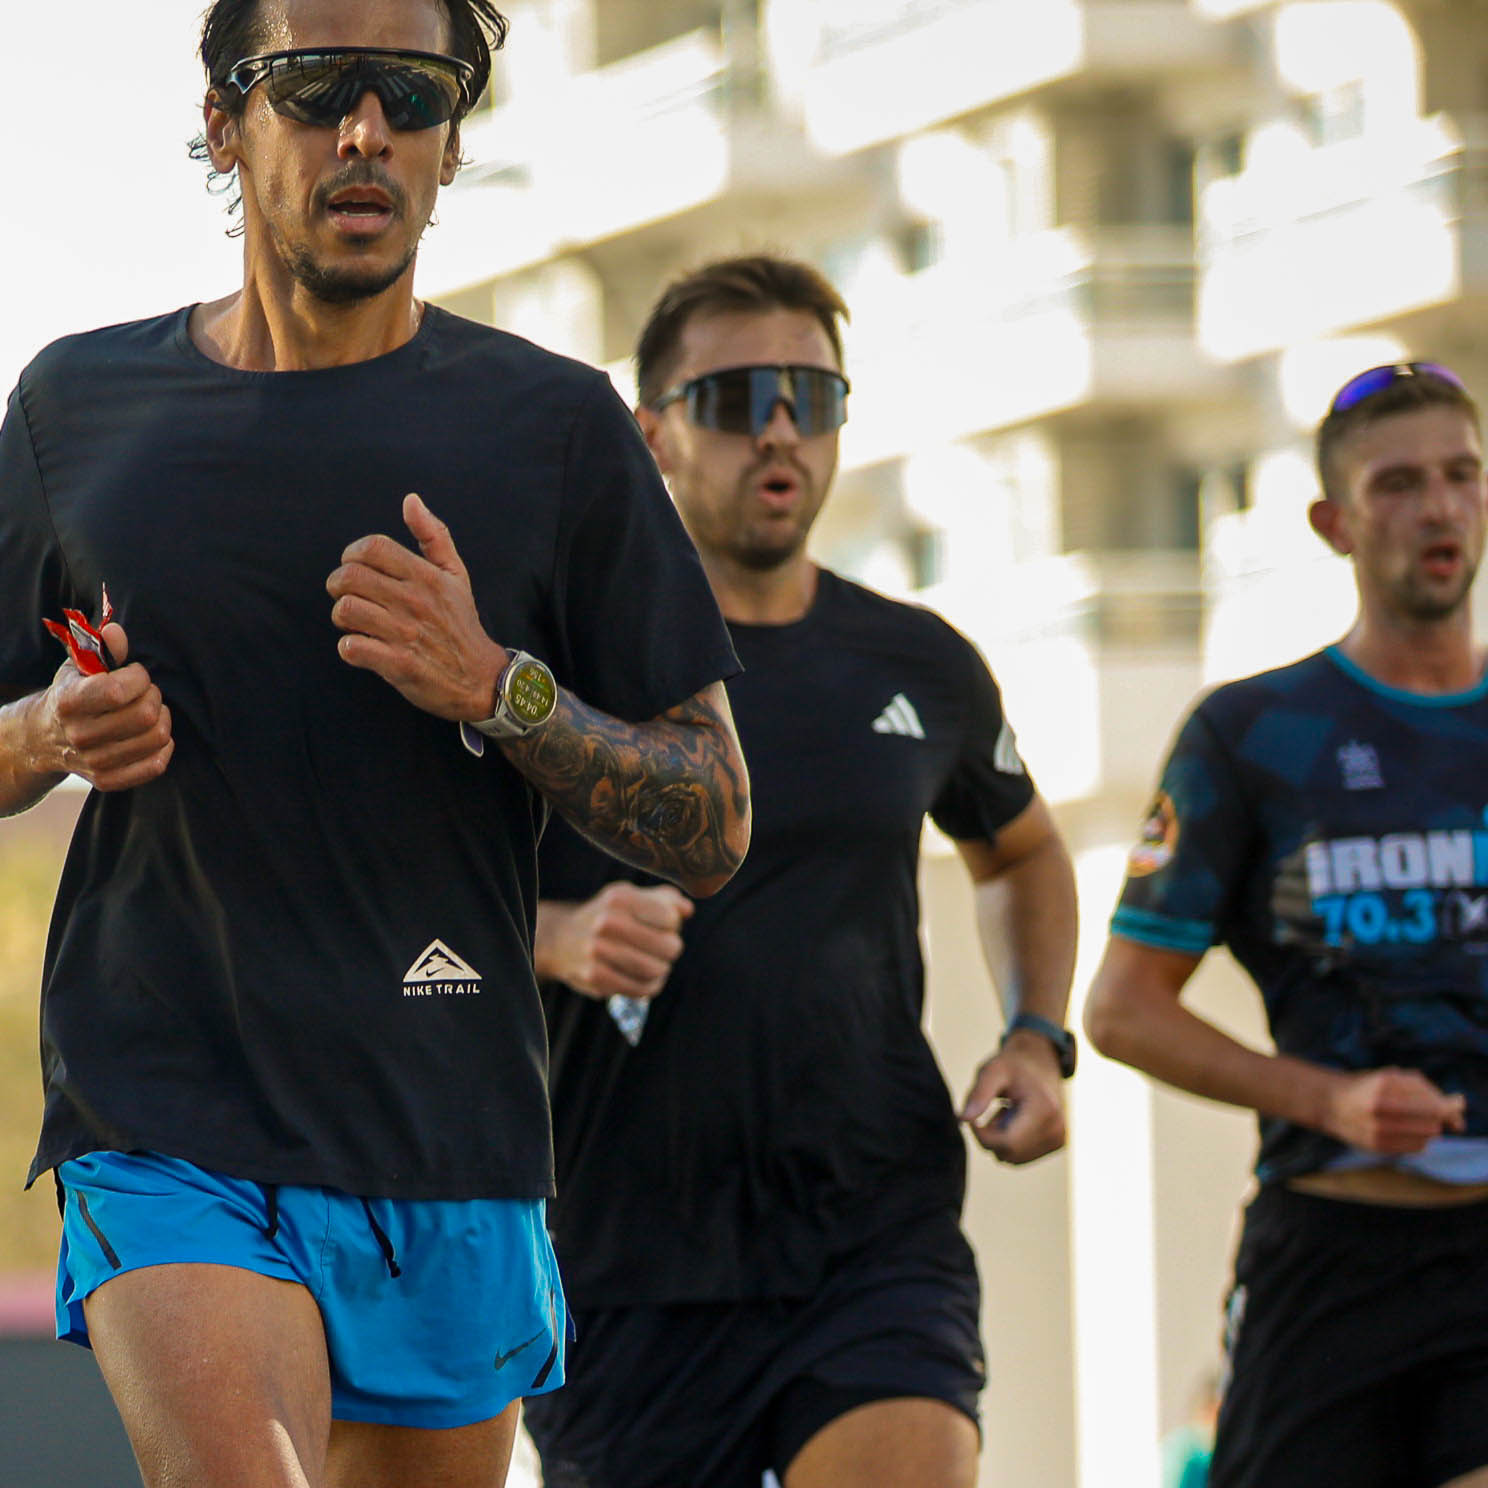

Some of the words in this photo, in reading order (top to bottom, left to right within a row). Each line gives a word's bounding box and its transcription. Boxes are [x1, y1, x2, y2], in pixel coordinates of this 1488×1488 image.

[1306, 829, 1488, 896] IRON
[1312, 889, 1436, 947] 70.3
[403, 985, 432, 997] NIKE
[436, 983, 481, 995] TRAIL
